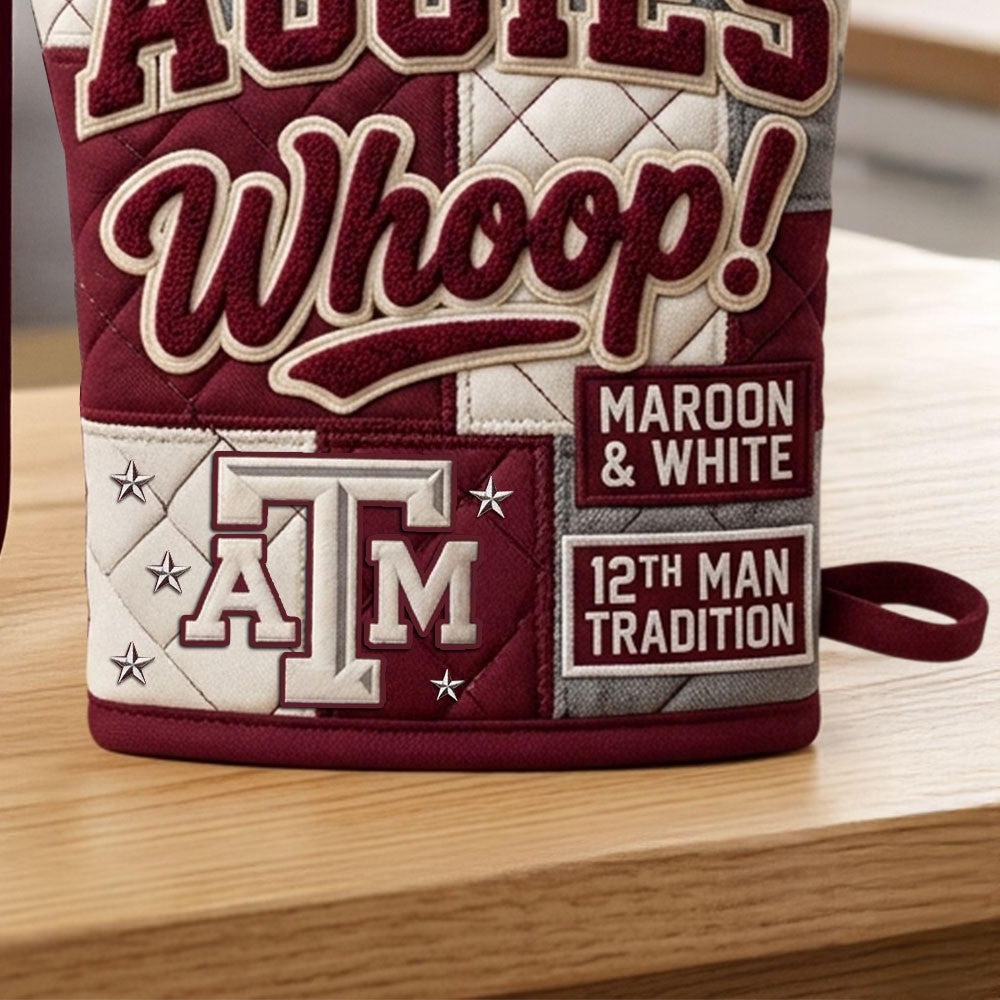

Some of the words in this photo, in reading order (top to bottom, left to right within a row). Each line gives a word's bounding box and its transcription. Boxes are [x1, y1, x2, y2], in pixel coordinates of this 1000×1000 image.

[108, 122, 804, 362] Whoop!
[600, 380, 794, 434] MAROON
[601, 441, 636, 488] &
[651, 434, 794, 486] WHITE
[590, 554, 682, 605] 12TH
[699, 548, 790, 601] MAN
[585, 602, 795, 656] TRADITION
